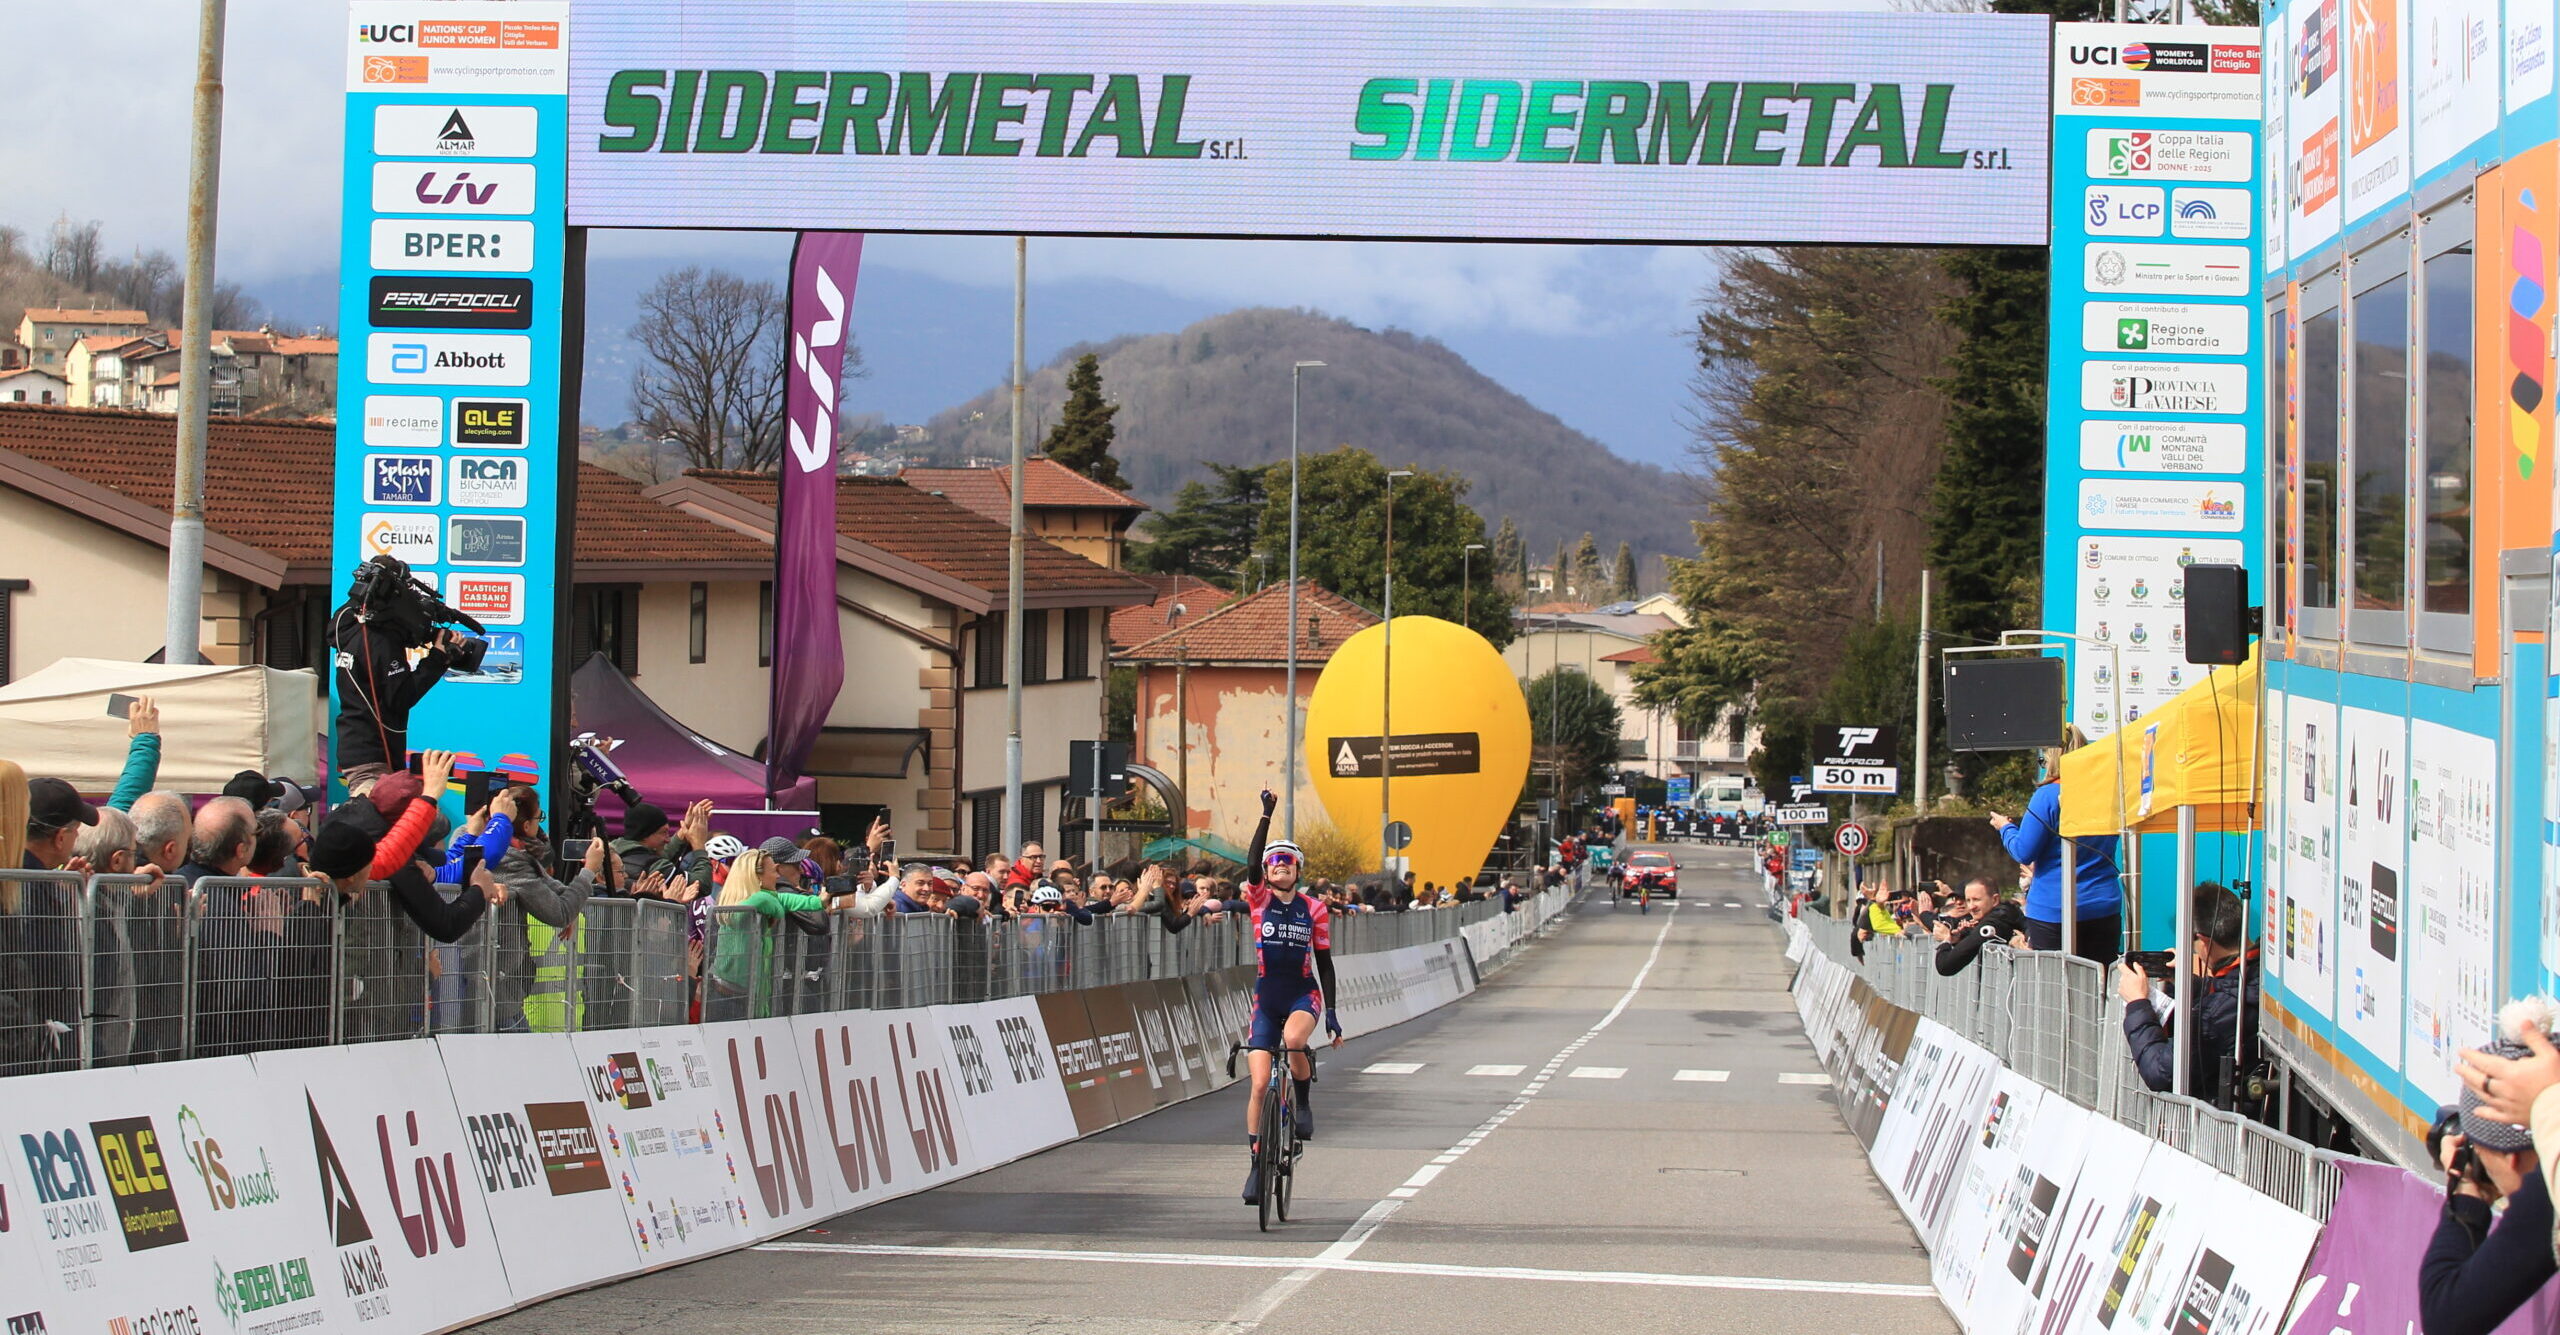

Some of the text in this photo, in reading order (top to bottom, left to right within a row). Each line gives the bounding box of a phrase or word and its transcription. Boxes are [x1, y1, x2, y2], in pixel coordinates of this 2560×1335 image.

[370, 25, 414, 43] UCI
[468, 26, 487, 34] CUP
[422, 35, 496, 44] JUNIOR WOMEN
[2070, 46, 2117, 65] UCI
[2156, 50, 2194, 58] WOMEN'S
[2214, 49, 2244, 59] Trofeo
[2156, 58, 2203, 66] WORLDTOUR
[2214, 59, 2251, 69] Cittiglio
[433, 64, 556, 77] www.cyclingsportpromotion.com
[599, 69, 1248, 160] SIDERMETAL s.r.l.
[1350, 78, 2012, 171] SIDERMETAL s.r.l.
[436, 141, 475, 151] ALMAR
[2158, 134, 2224, 146] Coppa Italia
[2158, 149, 2230, 163] delle Regioni
[2157, 163, 2188, 172] DONNE
[416, 172, 498, 205] Liv
[2119, 203, 2160, 220] LCP
[2164, 274, 2176, 282] per
[2185, 273, 2204, 283] Sport
[383, 292, 521, 307] PERUFFOCICLI
[2141, 305, 2179, 313] contributo
[2151, 323, 2204, 336] Regione
[2151, 336, 2219, 347] Lombardia
[434, 351, 505, 368] Abbott
[790, 265, 845, 473] Liv
[2134, 365, 2171, 374] patrocinio
[2128, 377, 2216, 409] PROVINCIA
[2145, 396, 2217, 411] di VARESE
[387, 417, 438, 428] reclame
[2117, 423, 2132, 431] Con
[2140, 424, 2176, 433] patrocinio
[2179, 424, 2186, 432] di
[464, 428, 512, 437] alecycling.com
[378, 459, 431, 482] Splash
[461, 459, 517, 480] RCA
[392, 475, 424, 494] SPA
[460, 480, 517, 490] BIGNAMI
[382, 493, 413, 501] TAMARO
[460, 491, 503, 499] CUSTOMIZED
[394, 525, 434, 533] GRUPPO
[380, 532, 433, 545] CELLINA
[464, 594, 507, 602] CASSANO
[589, 759, 608, 777] LYNX
[1336, 764, 1359, 772] ALMAR
[1823, 757, 1884, 765] PERUFFO.COM
[1825, 768, 1884, 785] 50 m
[1782, 810, 1825, 819] 100 m
[1842, 831, 1860, 847] 30
[587, 1065, 616, 1102] UCI
[888, 1022, 958, 1174] Liv
[815, 1026, 891, 1193] Liv
[728, 1036, 813, 1218] Liv
[20, 1128, 97, 1204] RCA
[376, 1110, 467, 1258] Liv
[43, 1201, 108, 1240] BIGNAMI
[124, 1208, 179, 1235] alecycling.com
[339, 1245, 389, 1298] ALMAR
[233, 1257, 316, 1313] SIDERLAGHI
[133, 1303, 200, 1335] reclame
